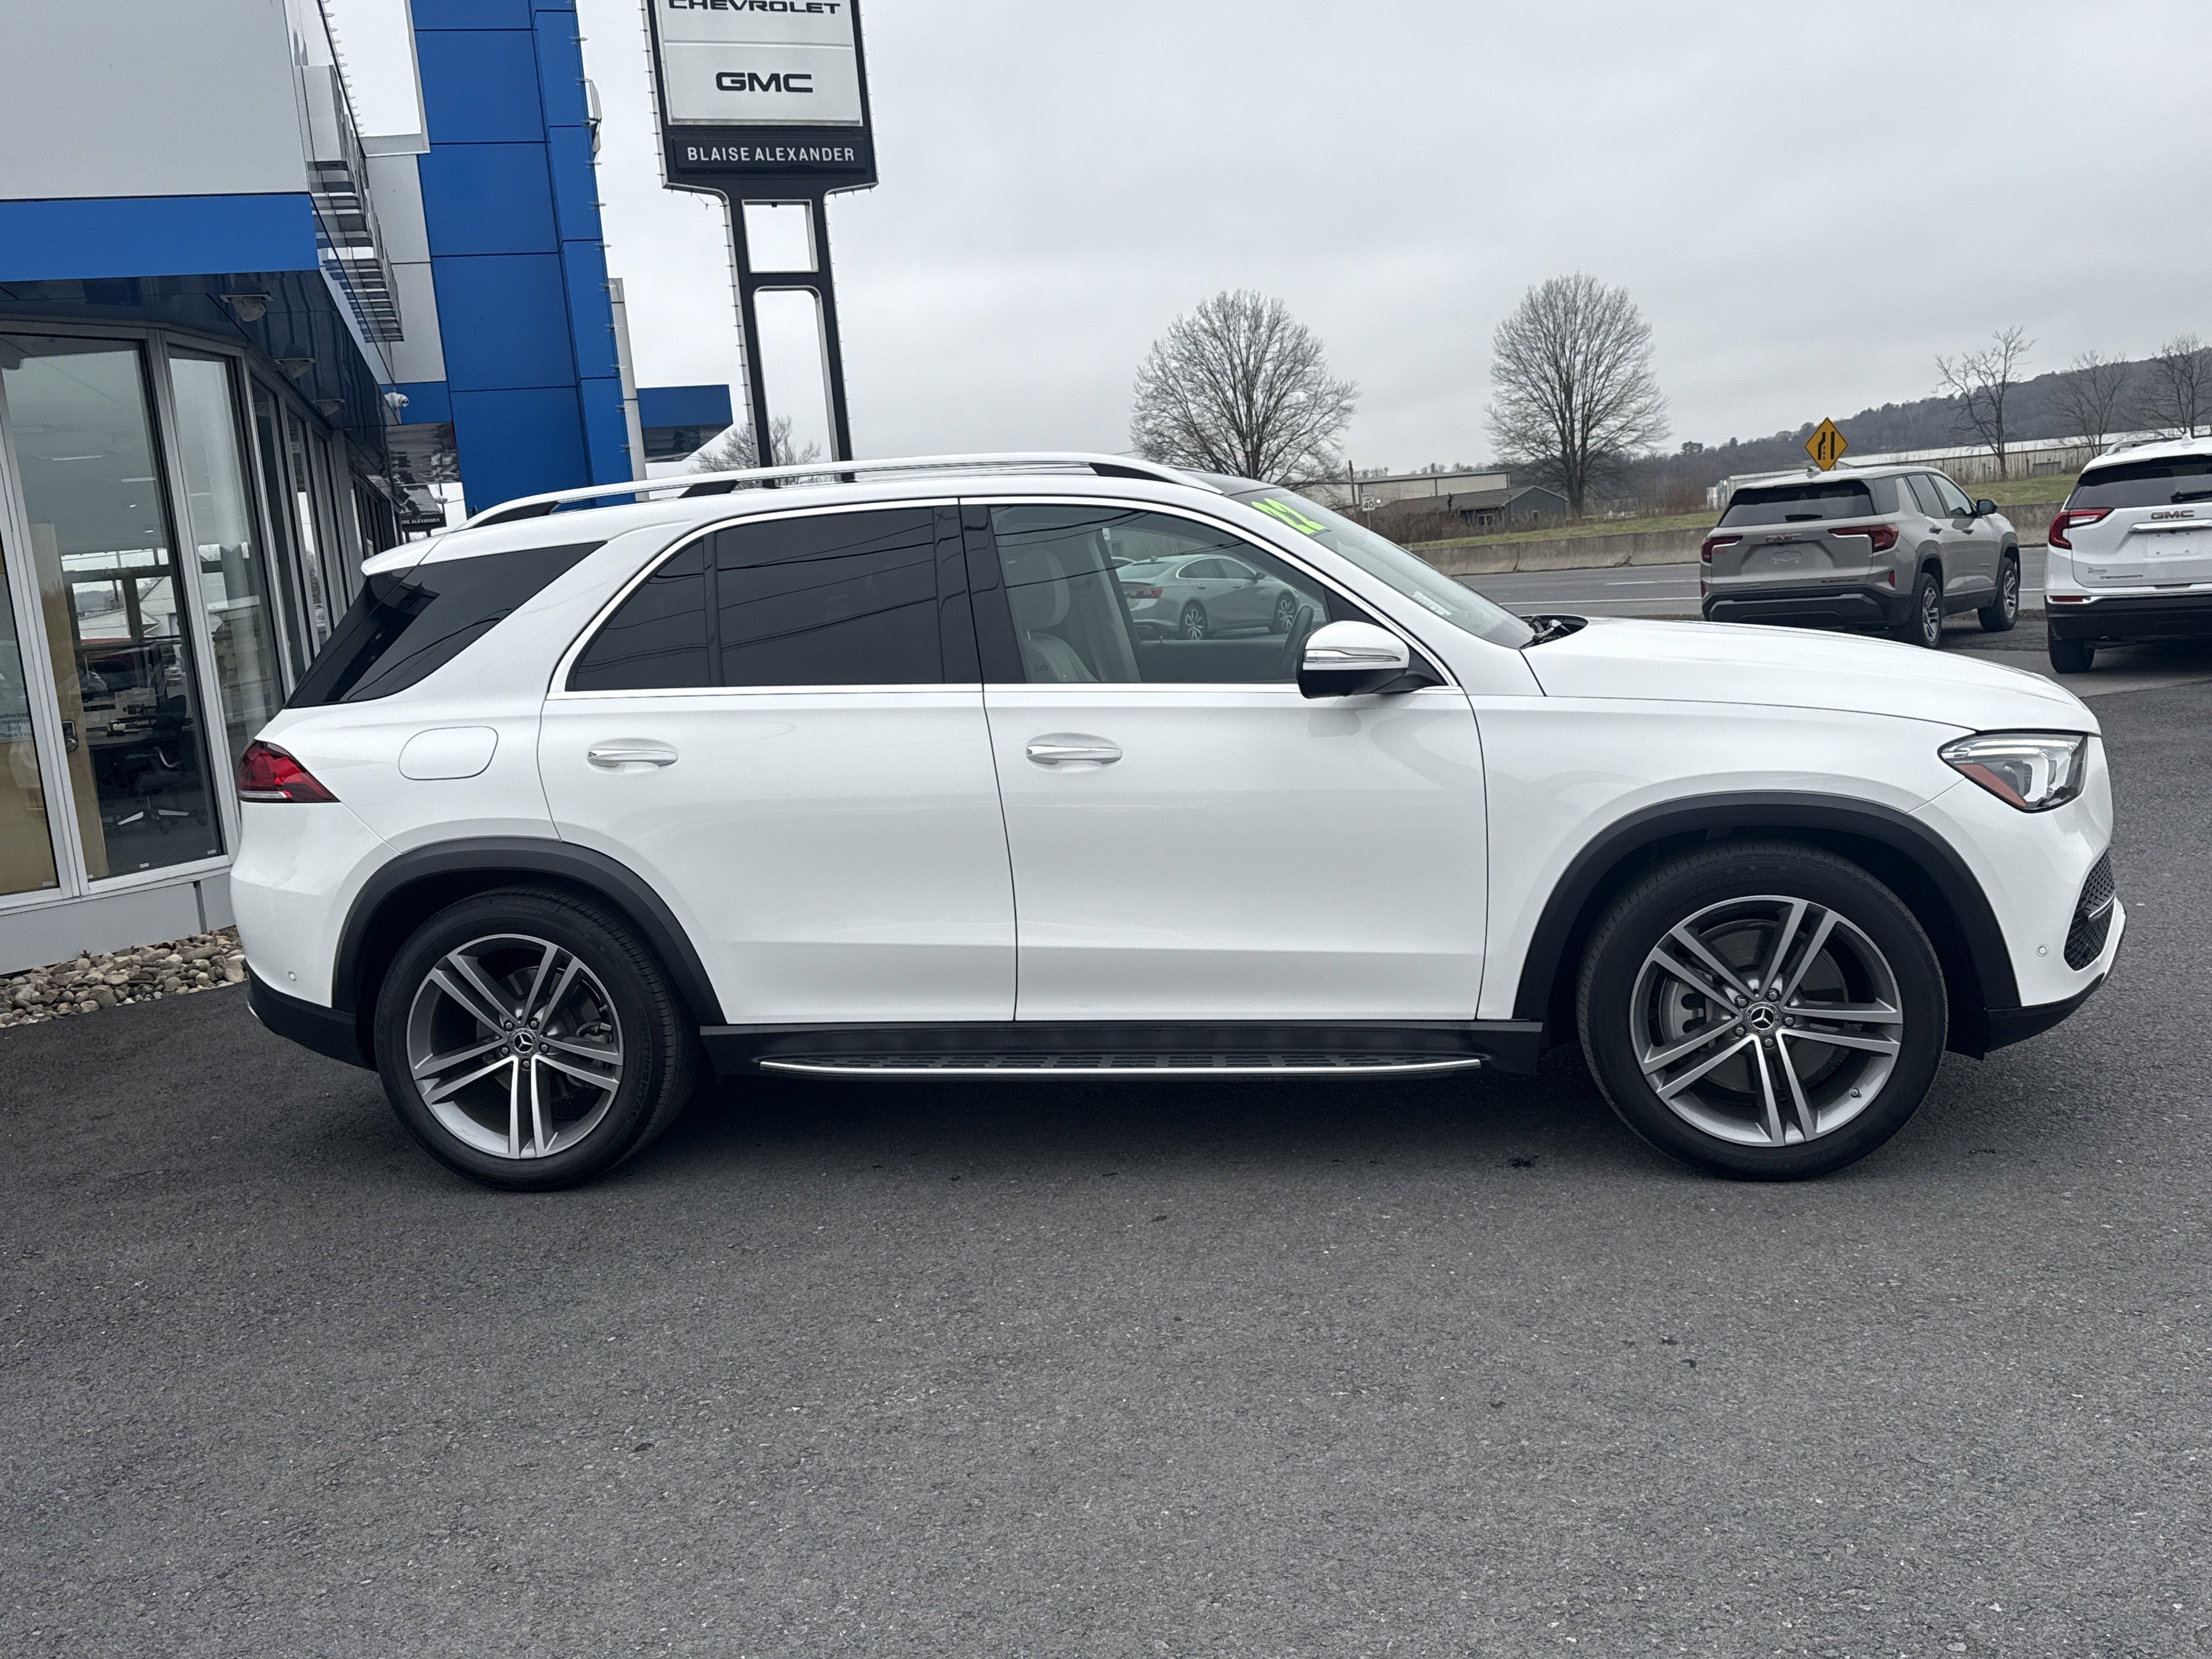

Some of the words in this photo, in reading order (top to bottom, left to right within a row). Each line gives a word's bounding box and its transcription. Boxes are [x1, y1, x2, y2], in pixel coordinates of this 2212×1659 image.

[669, 0, 840, 14] CHEVROLET
[715, 72, 813, 93] GMC
[687, 146, 750, 161] BLAISE
[755, 147, 855, 161] ALEXANDER
[2151, 510, 2194, 520] GMC
[1766, 533, 1802, 543] GMC
